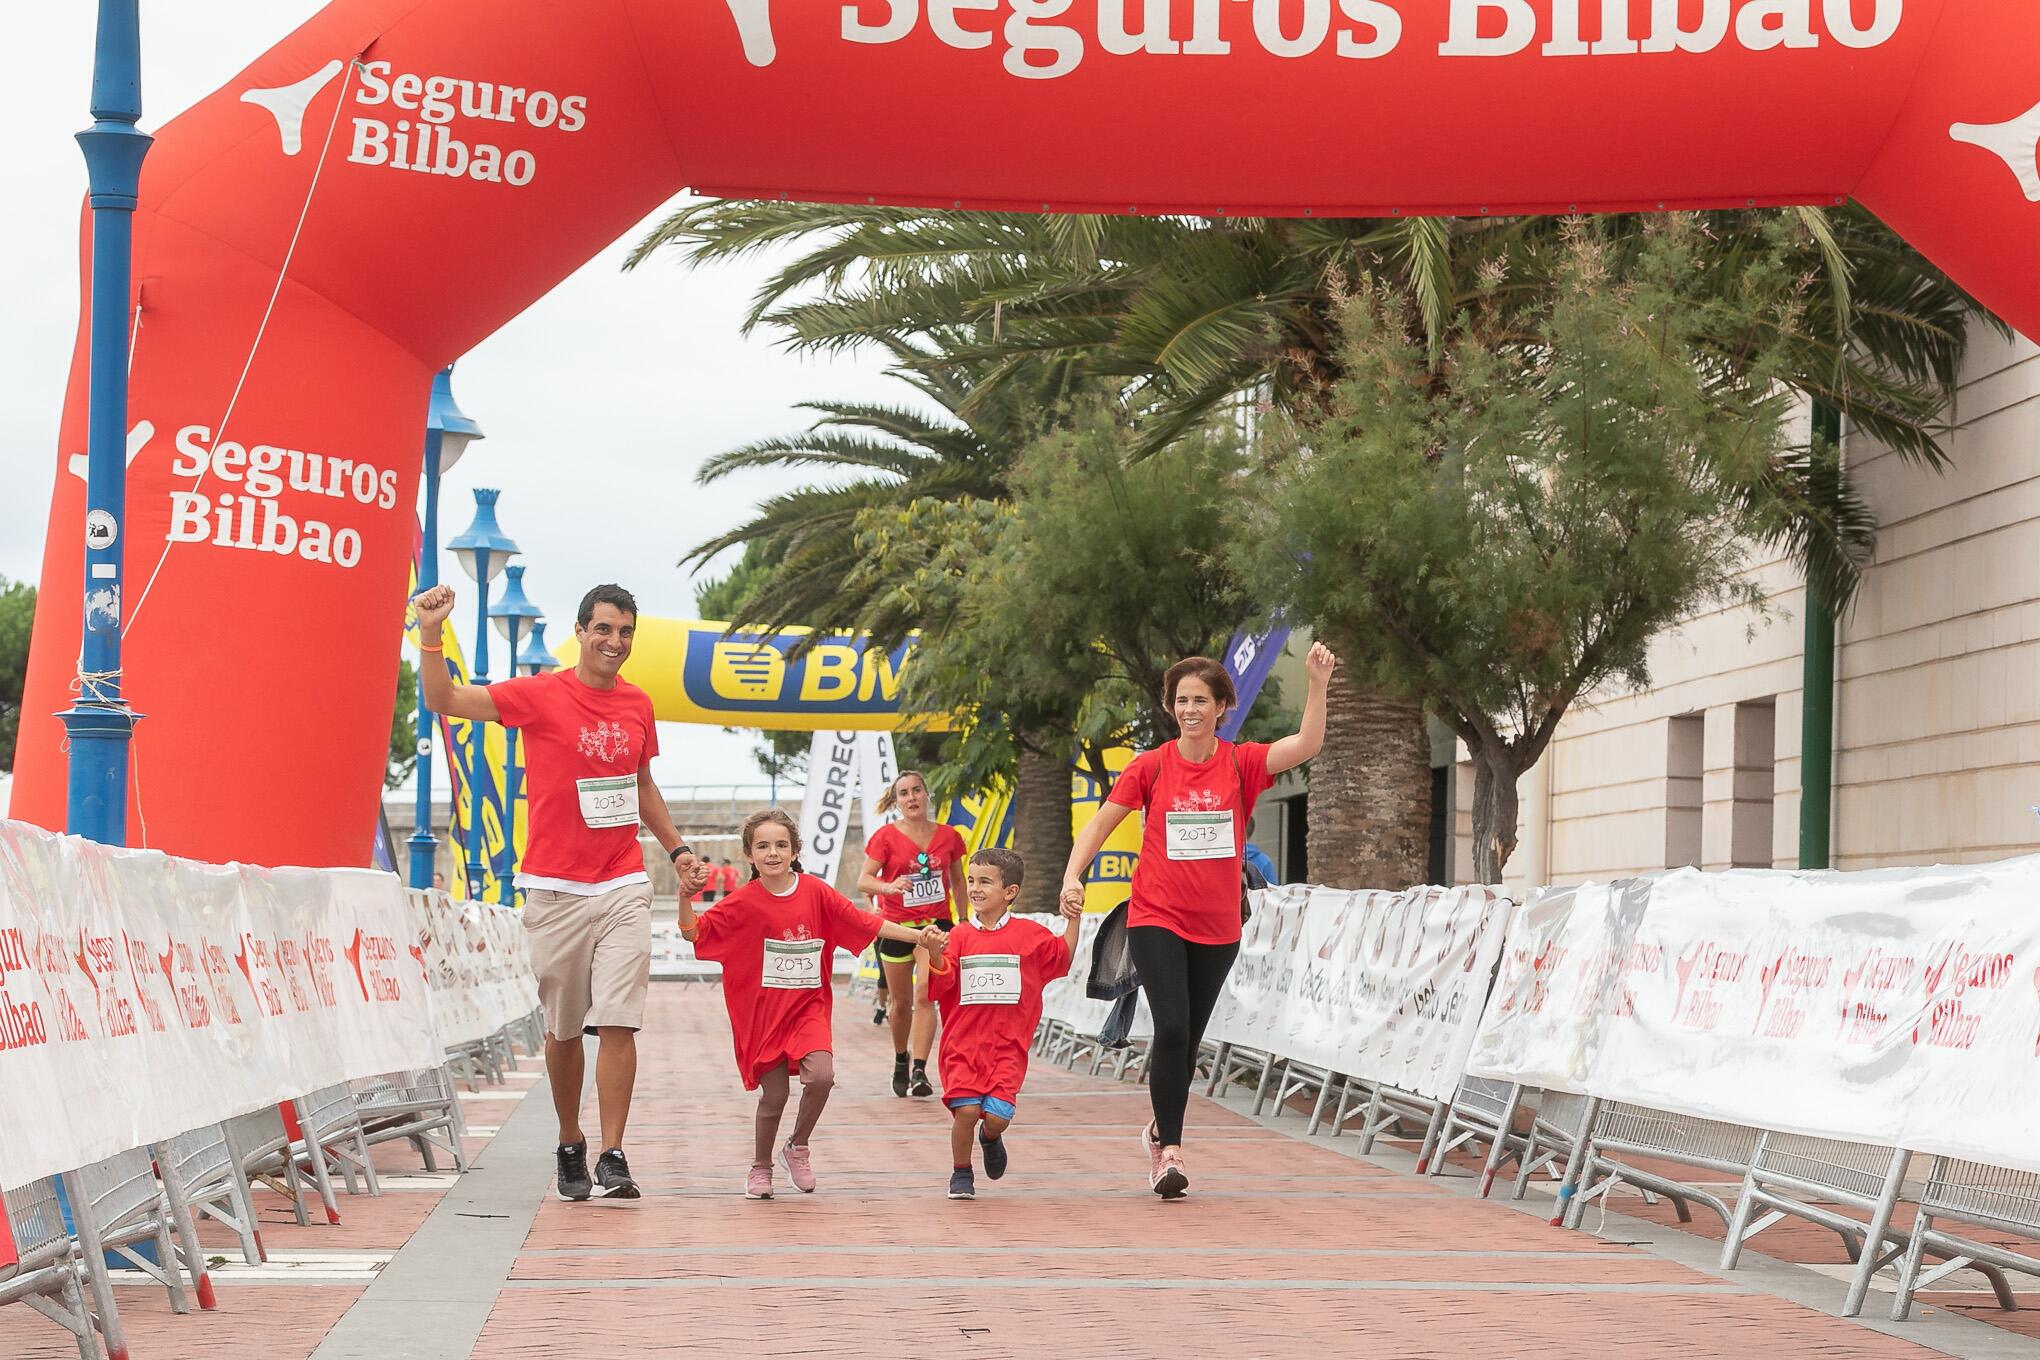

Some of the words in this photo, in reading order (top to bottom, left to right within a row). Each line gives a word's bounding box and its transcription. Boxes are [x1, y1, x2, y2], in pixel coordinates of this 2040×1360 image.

[356, 60, 588, 132] Seguros
[347, 117, 536, 186] Bilbao
[172, 425, 398, 510] Seguros
[165, 491, 362, 567] Bilbao
[593, 793, 626, 810] 2073
[1178, 826, 1218, 842] 2073
[809, 863, 829, 880] L
[774, 956, 814, 972] 2073
[968, 973, 1005, 988] 2073
